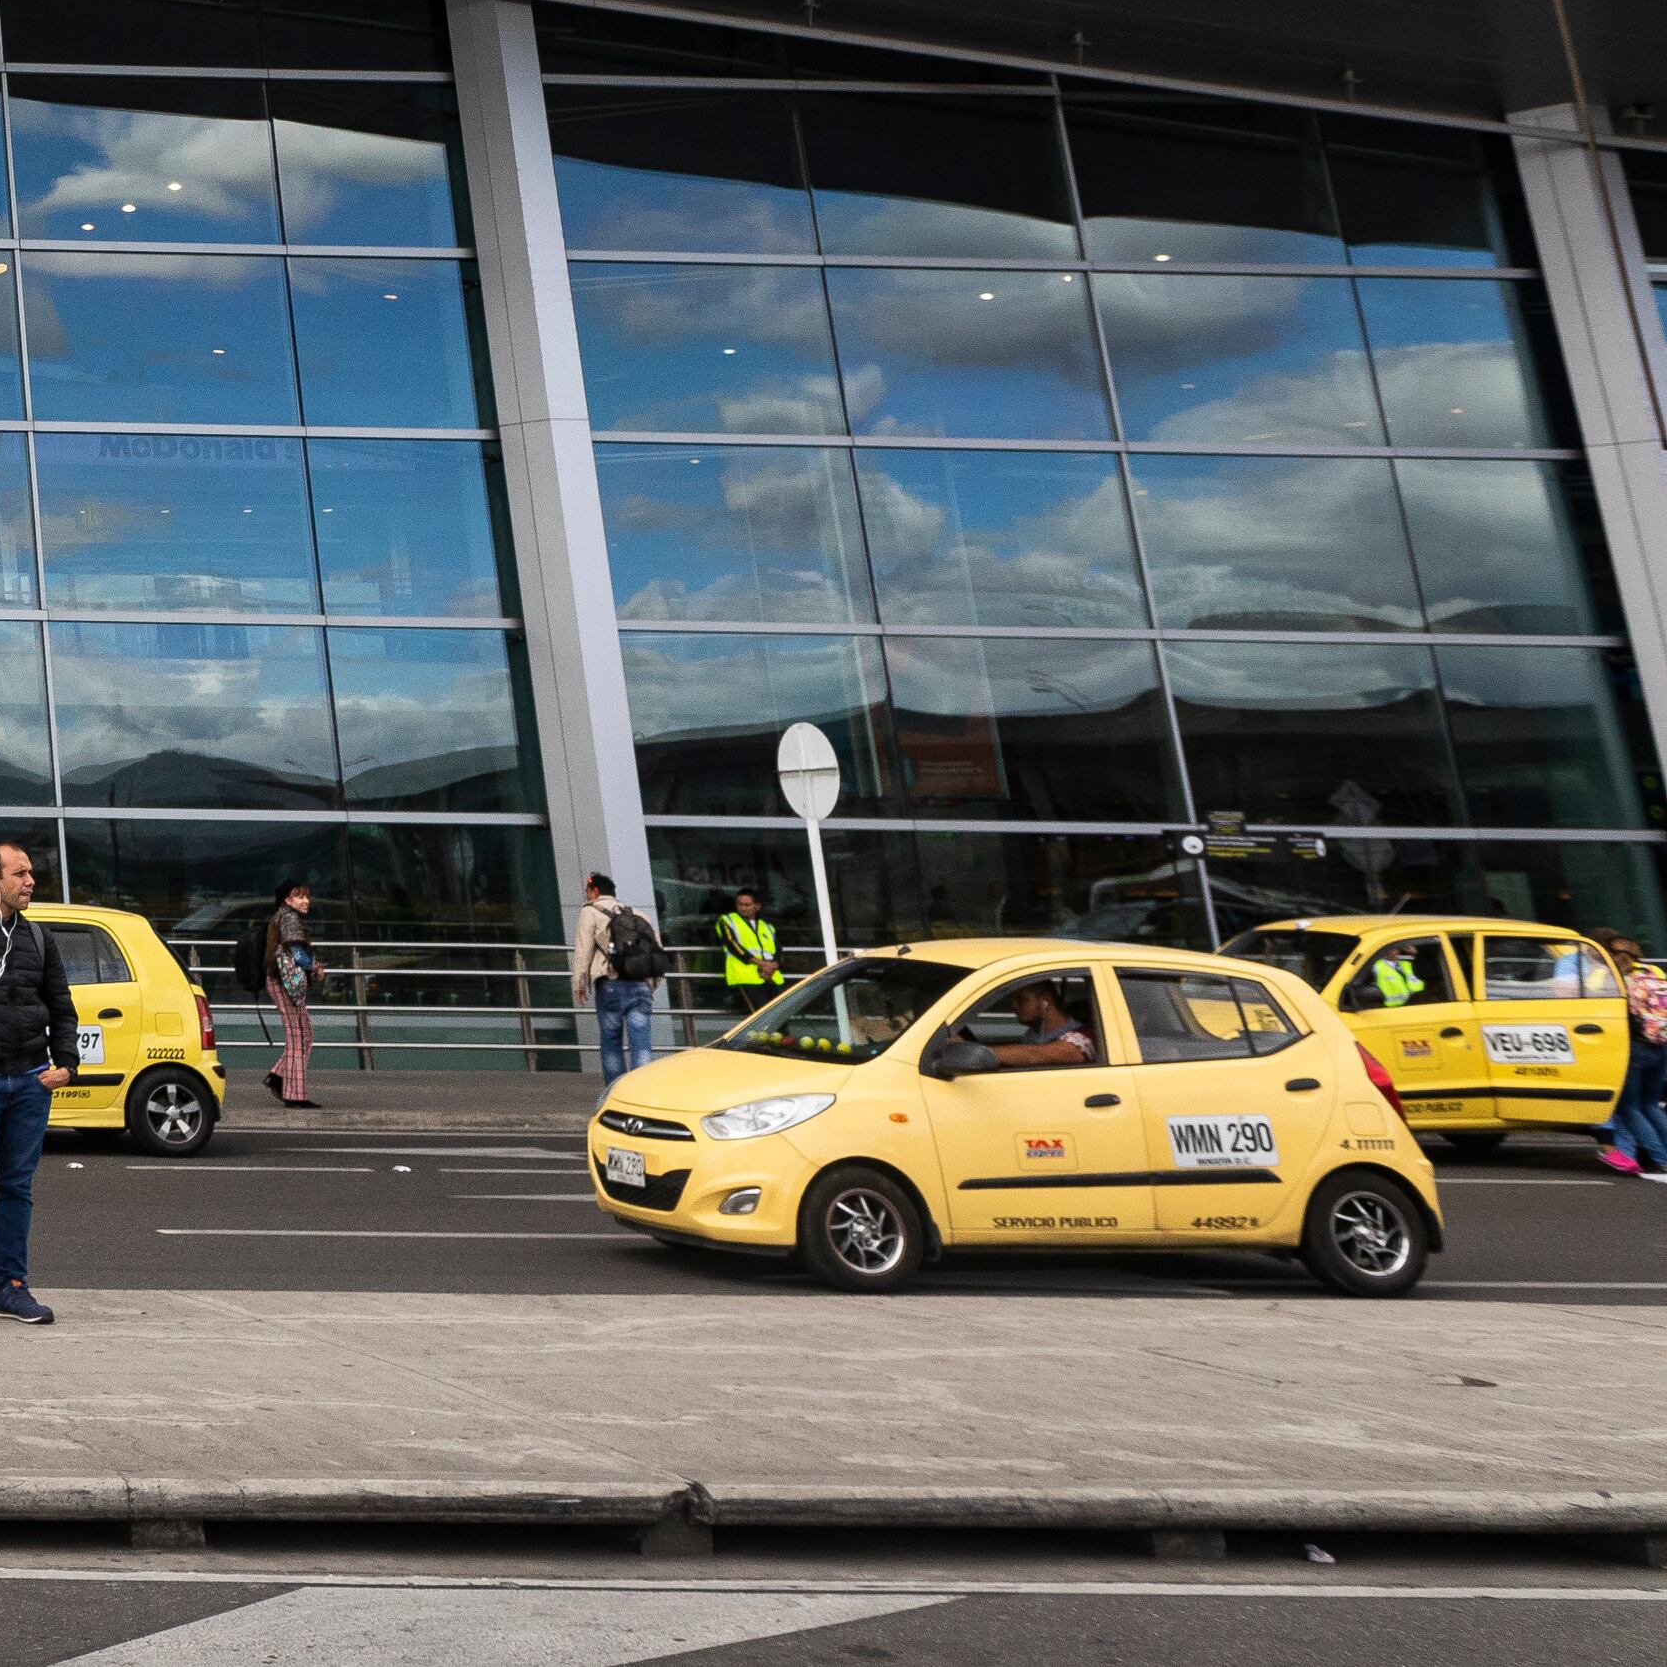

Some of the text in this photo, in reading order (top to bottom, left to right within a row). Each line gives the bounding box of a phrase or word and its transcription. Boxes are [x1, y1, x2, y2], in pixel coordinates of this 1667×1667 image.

[1169, 1122, 1274, 1154] WMN 290
[993, 1216, 1118, 1229] SERVICIO PUBLICO
